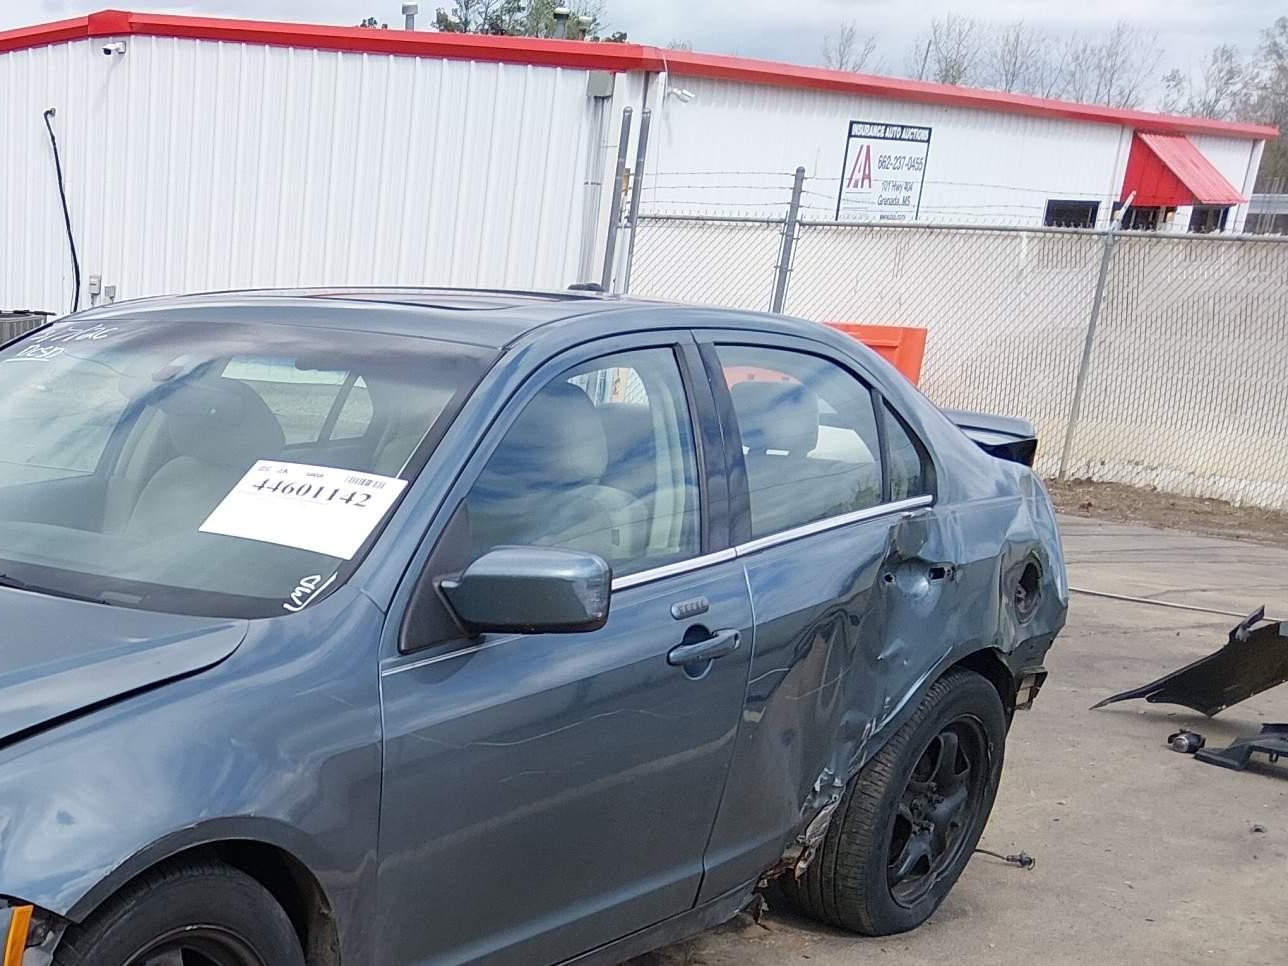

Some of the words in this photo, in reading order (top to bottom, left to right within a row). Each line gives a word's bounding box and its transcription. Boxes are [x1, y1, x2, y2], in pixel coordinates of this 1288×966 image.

[852, 124, 885, 137] INSURANCE
[886, 126, 902, 138] AUTO
[902, 128, 929, 140] AUCTIONS
[878, 155, 923, 171] 662-237-0455
[252, 478, 372, 508] 44601142
